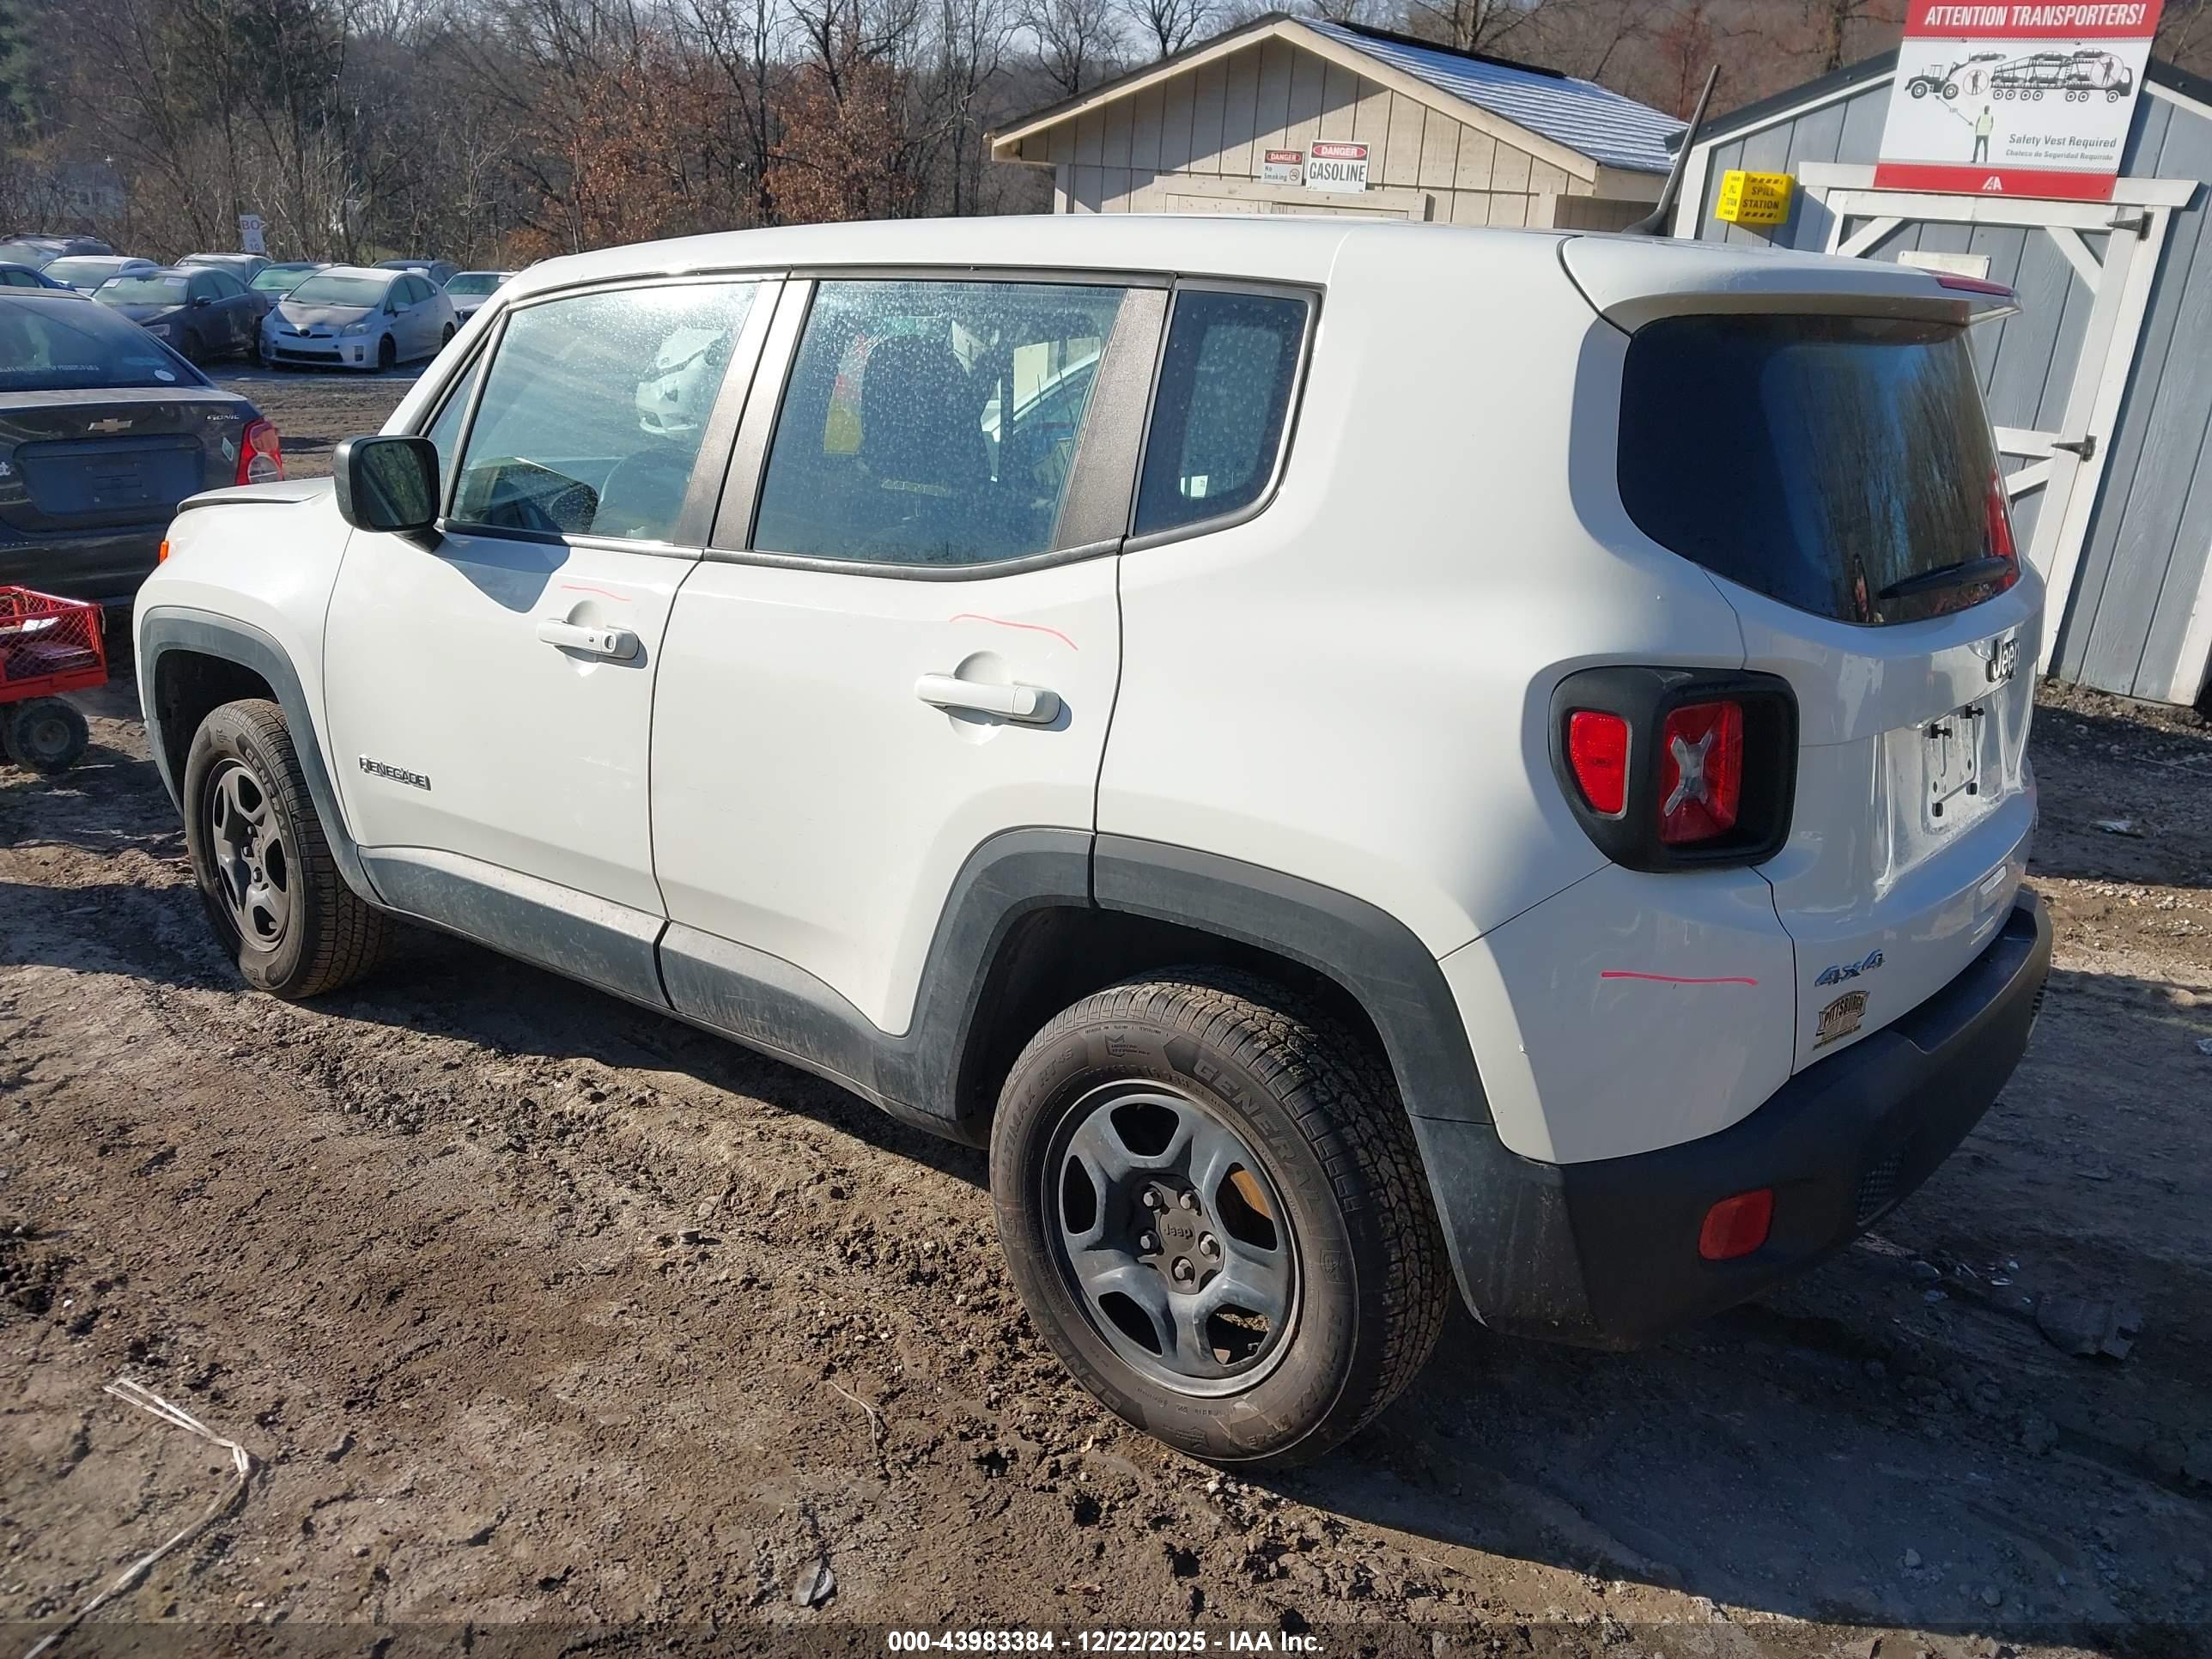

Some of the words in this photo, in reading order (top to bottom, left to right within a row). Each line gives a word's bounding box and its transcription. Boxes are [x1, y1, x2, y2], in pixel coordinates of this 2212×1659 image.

[1924, 5, 2008, 27] ATTENTION
[2012, 3, 2146, 26] TRANSPORTERS!
[2009, 134, 2041, 147] Safety
[2045, 135, 2066, 146] Vest
[2069, 136, 2117, 149] Required
[1271, 153, 1297, 161] DANGER
[1321, 146, 1358, 156] DANGER
[2006, 149, 2033, 157] Chaleco
[2044, 150, 2078, 160] Seguridad
[1264, 173, 1287, 182] Smoking
[1310, 161, 1366, 182] GASOLINE
[1751, 185, 1775, 197] SPILL
[1742, 198, 1780, 210] STATION
[358, 757, 428, 788] RENEGADE
[1814, 949, 1883, 987] 4x4
[1164, 1224, 1194, 1240] Jeep
